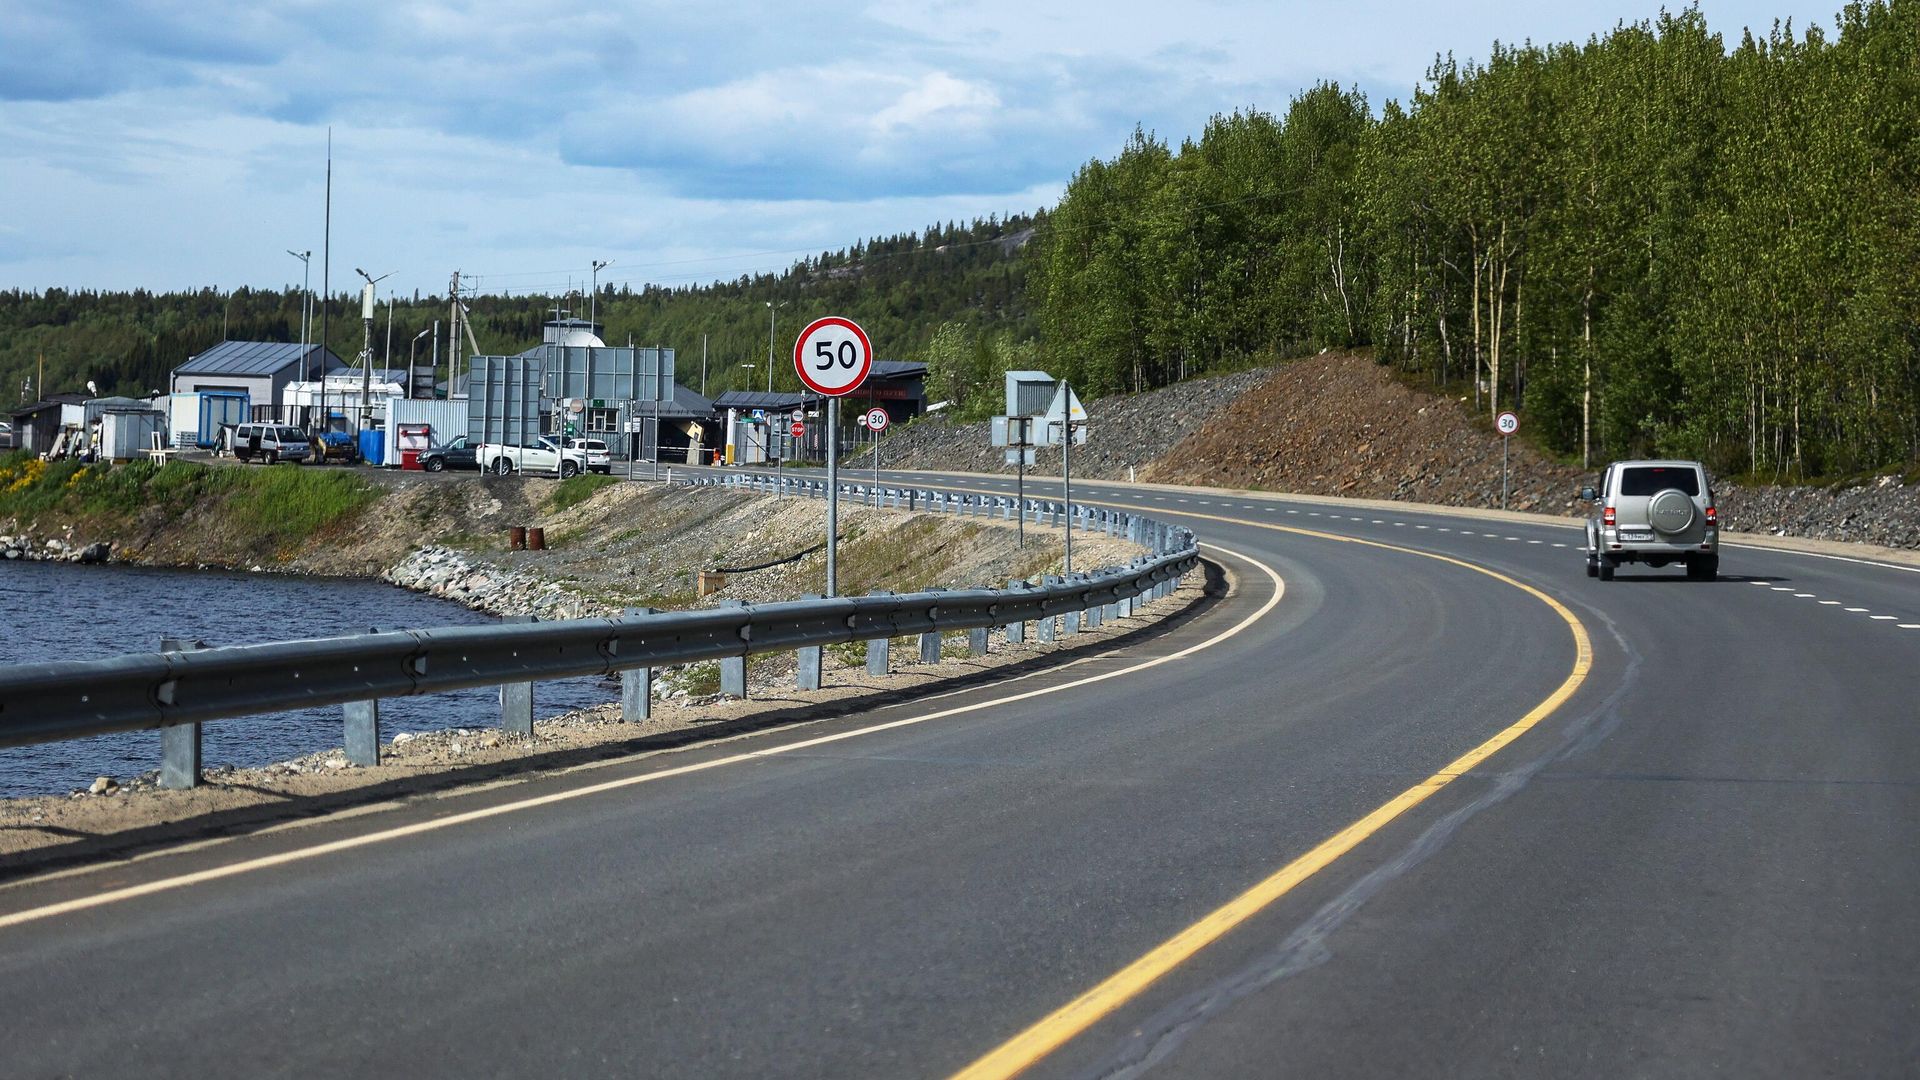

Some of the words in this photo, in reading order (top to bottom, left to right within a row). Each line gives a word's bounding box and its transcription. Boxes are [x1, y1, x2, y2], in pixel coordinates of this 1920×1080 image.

[816, 341, 857, 370] 50
[871, 415, 883, 424] 30
[1501, 419, 1514, 428] 30
